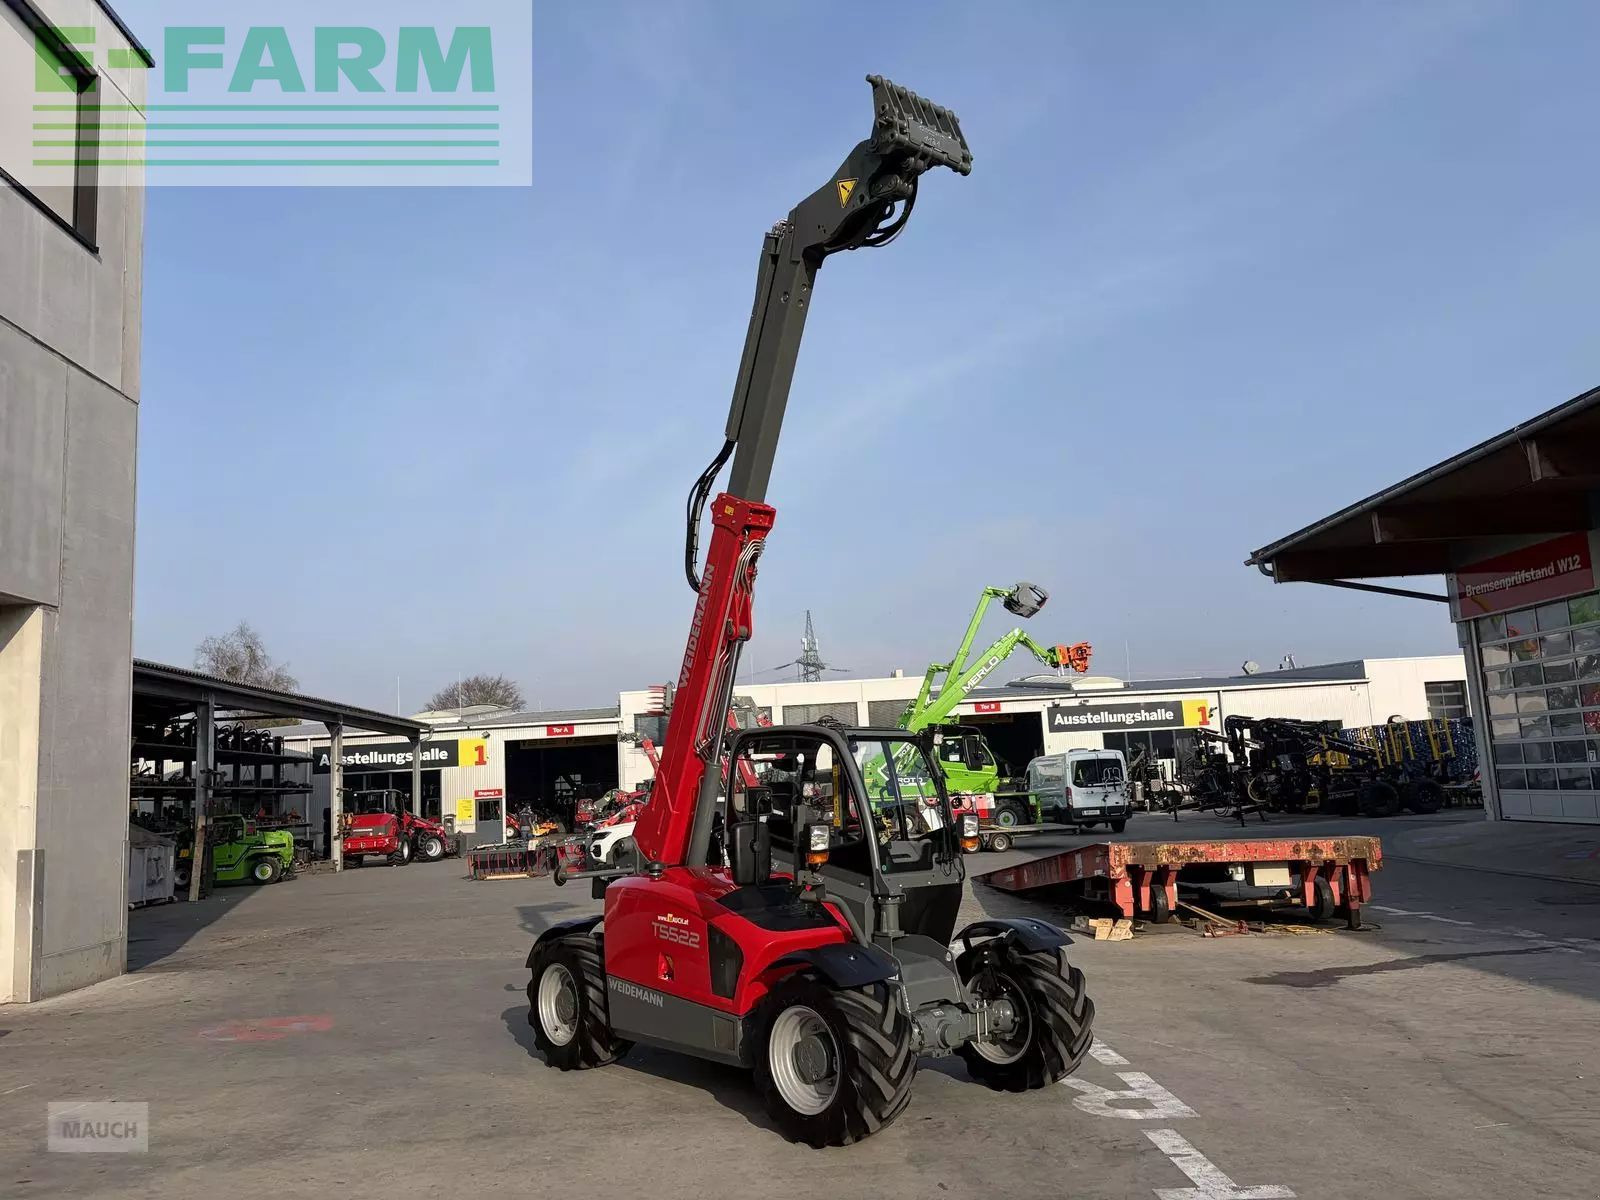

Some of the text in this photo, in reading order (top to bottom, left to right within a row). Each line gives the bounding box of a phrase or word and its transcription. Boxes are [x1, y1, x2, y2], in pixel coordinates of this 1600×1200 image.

[1465, 554, 1582, 597] Bremsenprüfstand W12
[679, 563, 715, 688] WEIDEMANN
[961, 655, 999, 694] MERLO
[1054, 706, 1210, 726] Ausstellungshalle 1
[319, 745, 487, 767] Asstellungsalle 1
[608, 978, 663, 1008] WEIDEMANN
